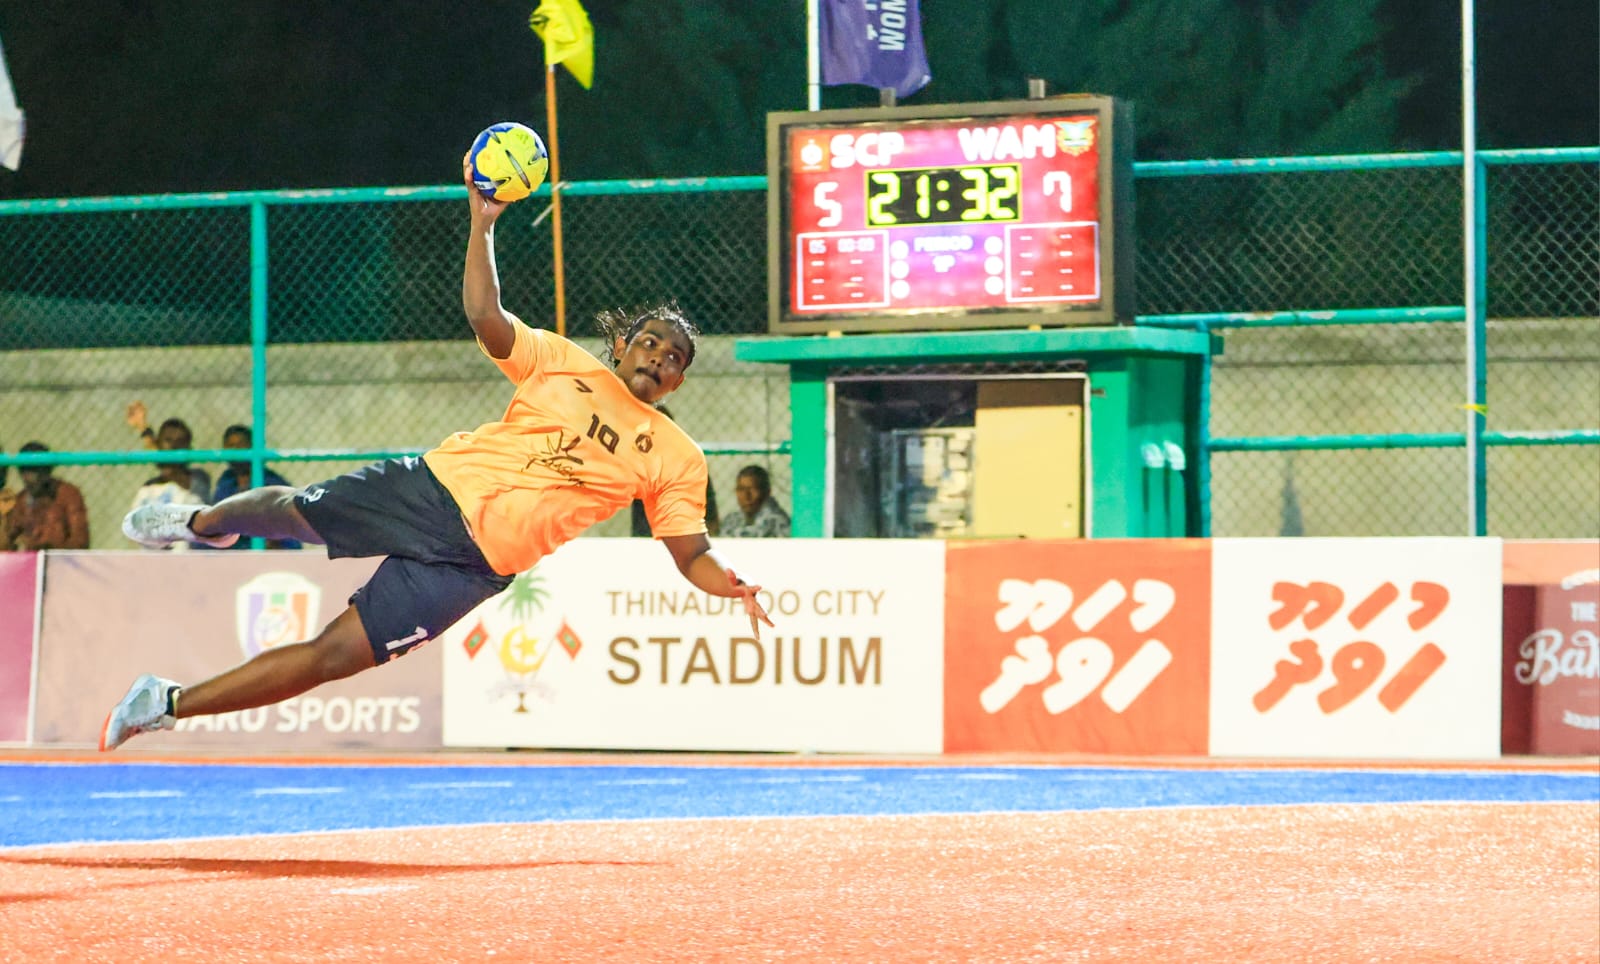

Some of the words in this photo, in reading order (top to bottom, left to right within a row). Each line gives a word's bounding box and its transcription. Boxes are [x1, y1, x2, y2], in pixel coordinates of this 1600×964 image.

[830, 132, 905, 168] SCP
[958, 124, 1057, 161] WAM
[813, 182, 842, 228] 5
[868, 167, 1018, 224] 21:32
[1043, 171, 1072, 212] 7
[586, 413, 620, 455] 10
[812, 589, 886, 616] CITY
[606, 635, 883, 686] STADIUM
[276, 696, 421, 734] SPORTS
